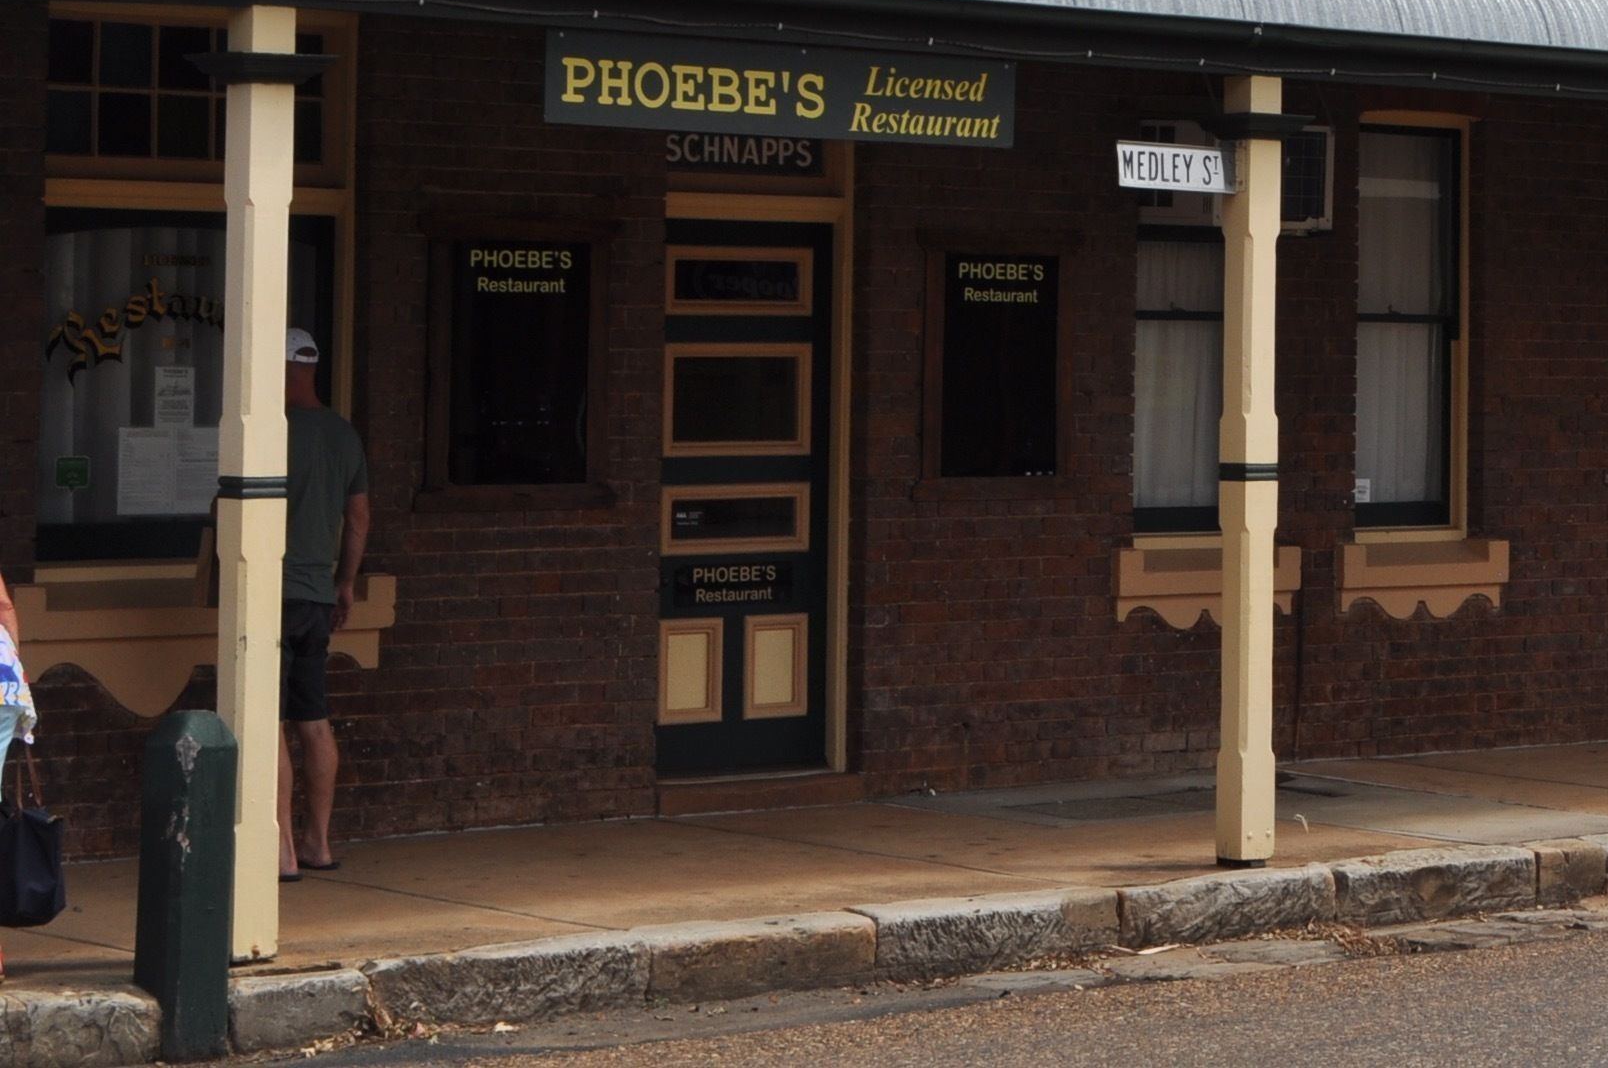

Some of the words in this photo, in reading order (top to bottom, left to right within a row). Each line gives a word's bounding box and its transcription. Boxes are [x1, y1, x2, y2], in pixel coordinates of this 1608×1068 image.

[561, 57, 825, 118] PHOEBE'S
[864, 66, 988, 102] Licensed
[848, 103, 1000, 139] Restaurant
[665, 133, 813, 168] SCHNAPPS
[1122, 149, 1193, 184] MEDLEY
[470, 249, 572, 269] PHOEBE'S
[959, 263, 1044, 281] PHOEBE'S
[478, 277, 566, 293] Restaurant
[964, 287, 1038, 303] Restaurant
[45, 276, 223, 388] Restau
[693, 565, 776, 583] PHOEBE'S
[695, 588, 772, 603] Restaurant
